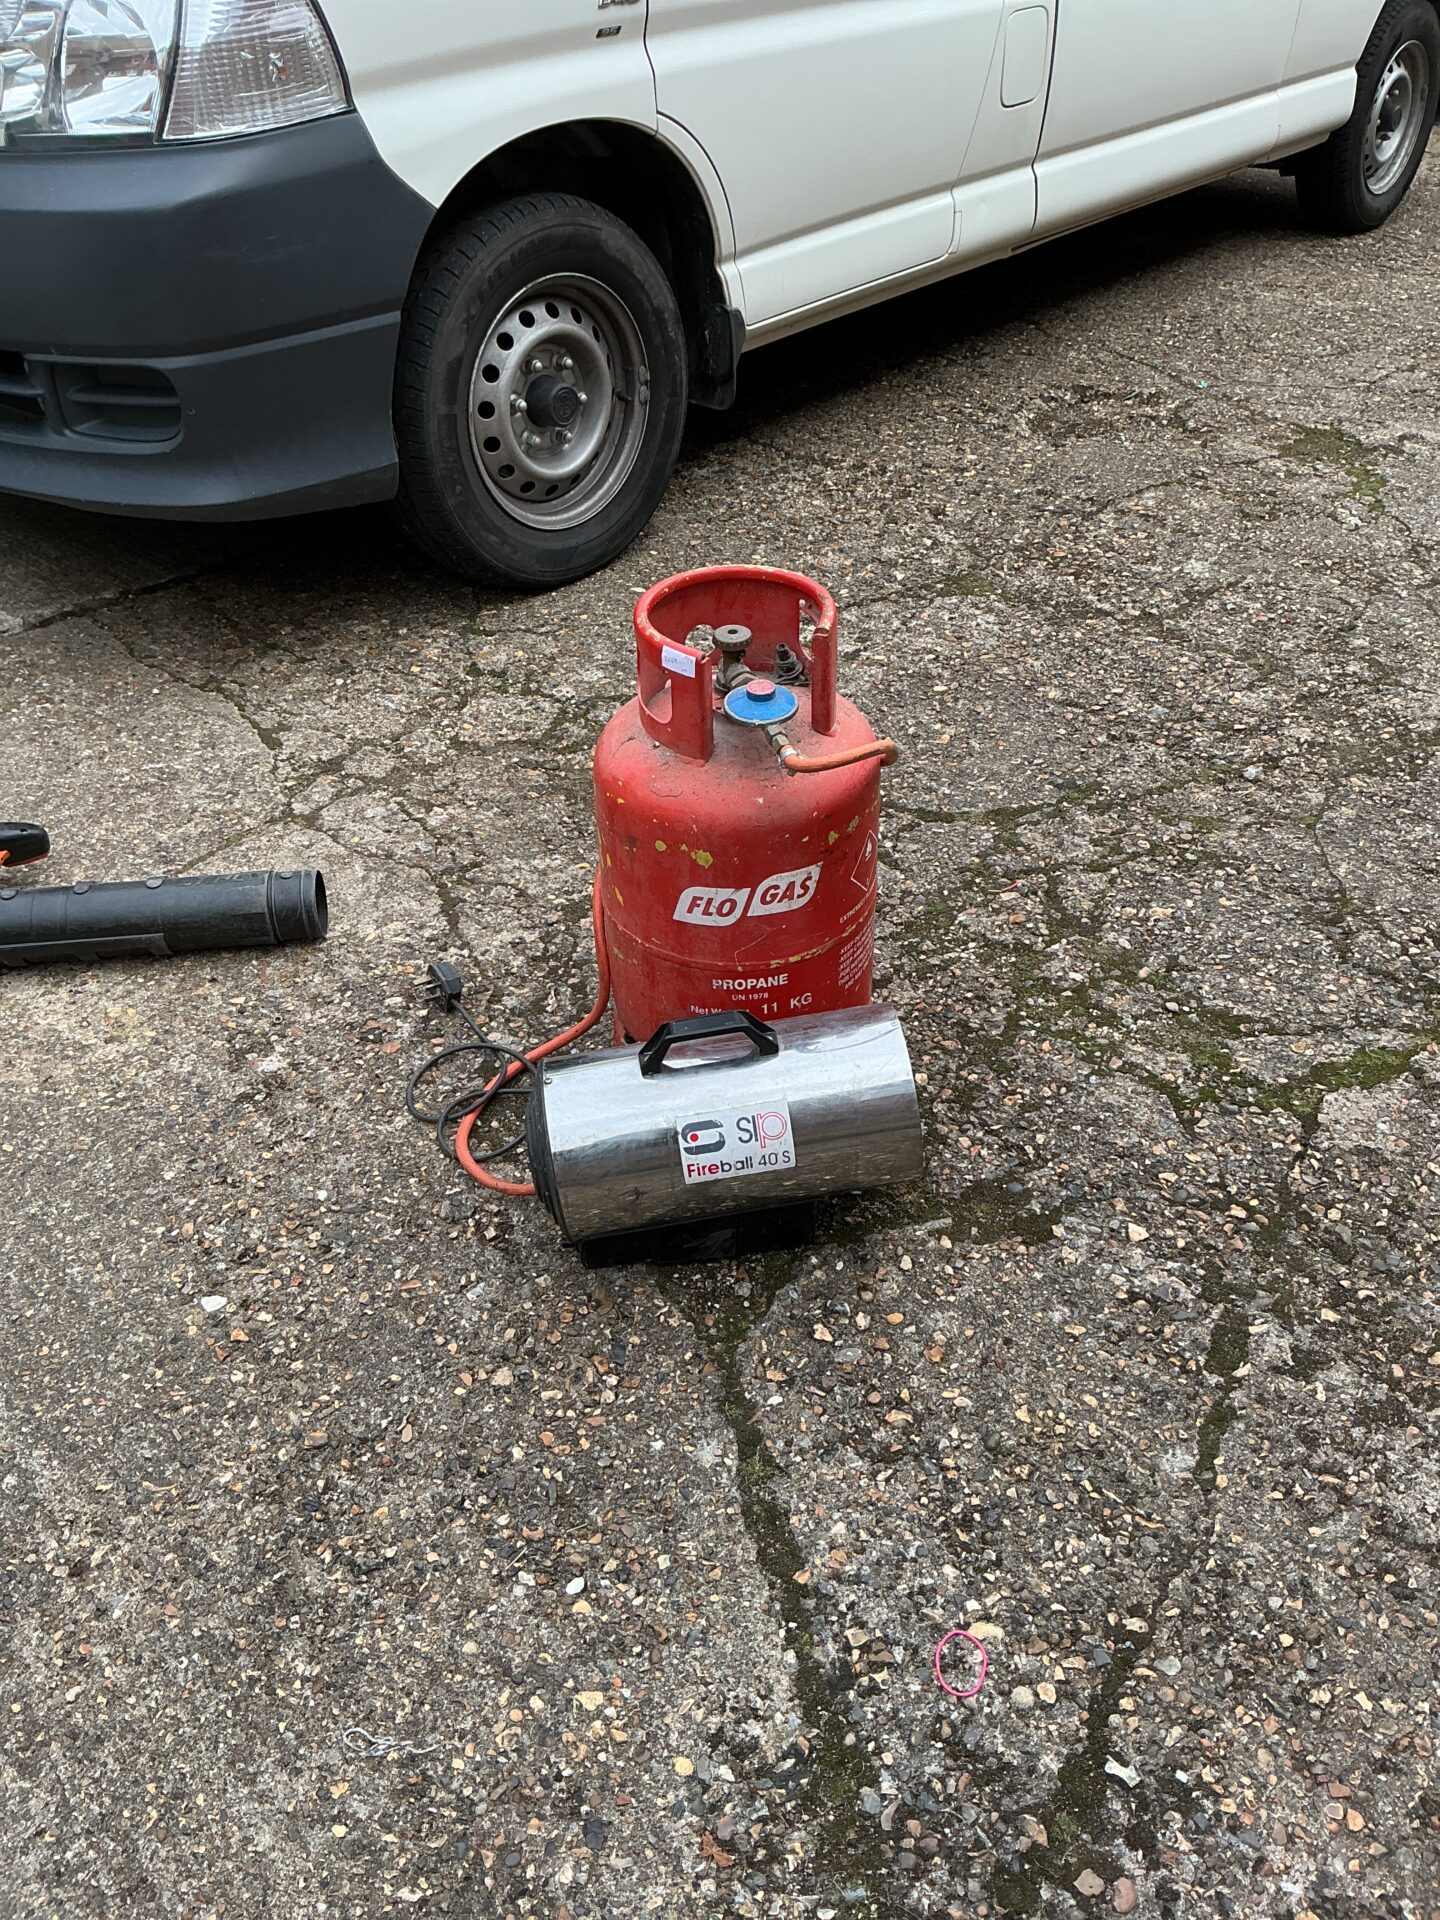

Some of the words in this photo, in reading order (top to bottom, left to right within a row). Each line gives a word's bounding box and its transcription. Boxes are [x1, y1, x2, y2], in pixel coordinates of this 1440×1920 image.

[686, 896, 738, 917] FLO
[760, 875, 813, 905] GAS
[712, 973, 789, 990] PROPANE
[690, 1005, 709, 1015] Net
[761, 1002, 778, 1014] 11
[790, 993, 812, 1009] KG
[749, 992, 769, 1000] 1978
[687, 1155, 754, 1178] Fireball
